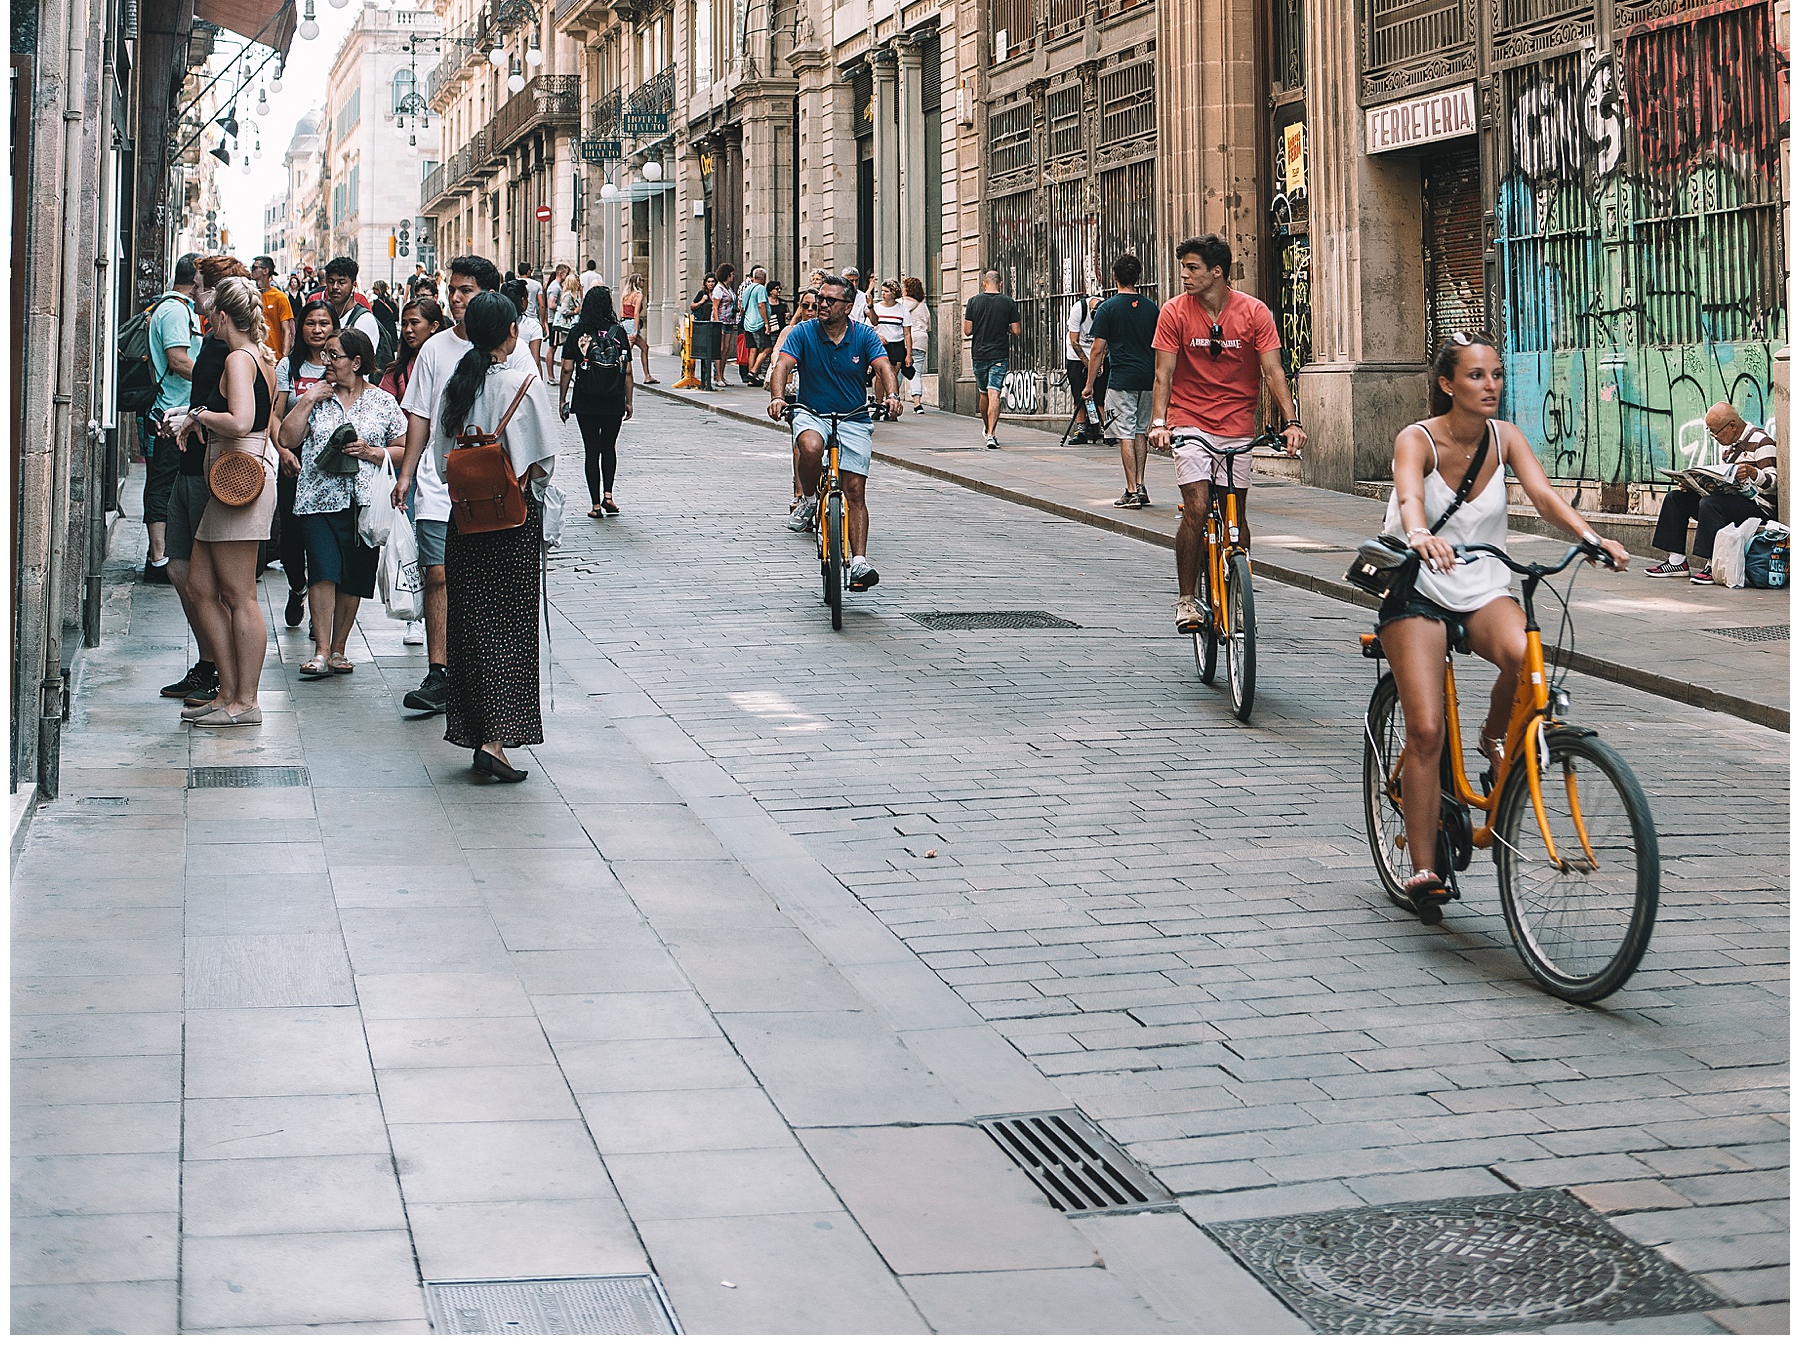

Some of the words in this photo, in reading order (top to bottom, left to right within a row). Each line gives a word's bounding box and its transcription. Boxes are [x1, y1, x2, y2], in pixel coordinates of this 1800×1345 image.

[627, 115, 660, 123] HOTEL
[1371, 92, 1471, 148] FERRETERIA
[627, 123, 665, 131] RIALTO
[1190, 338, 1242, 348] ABERMBIE
